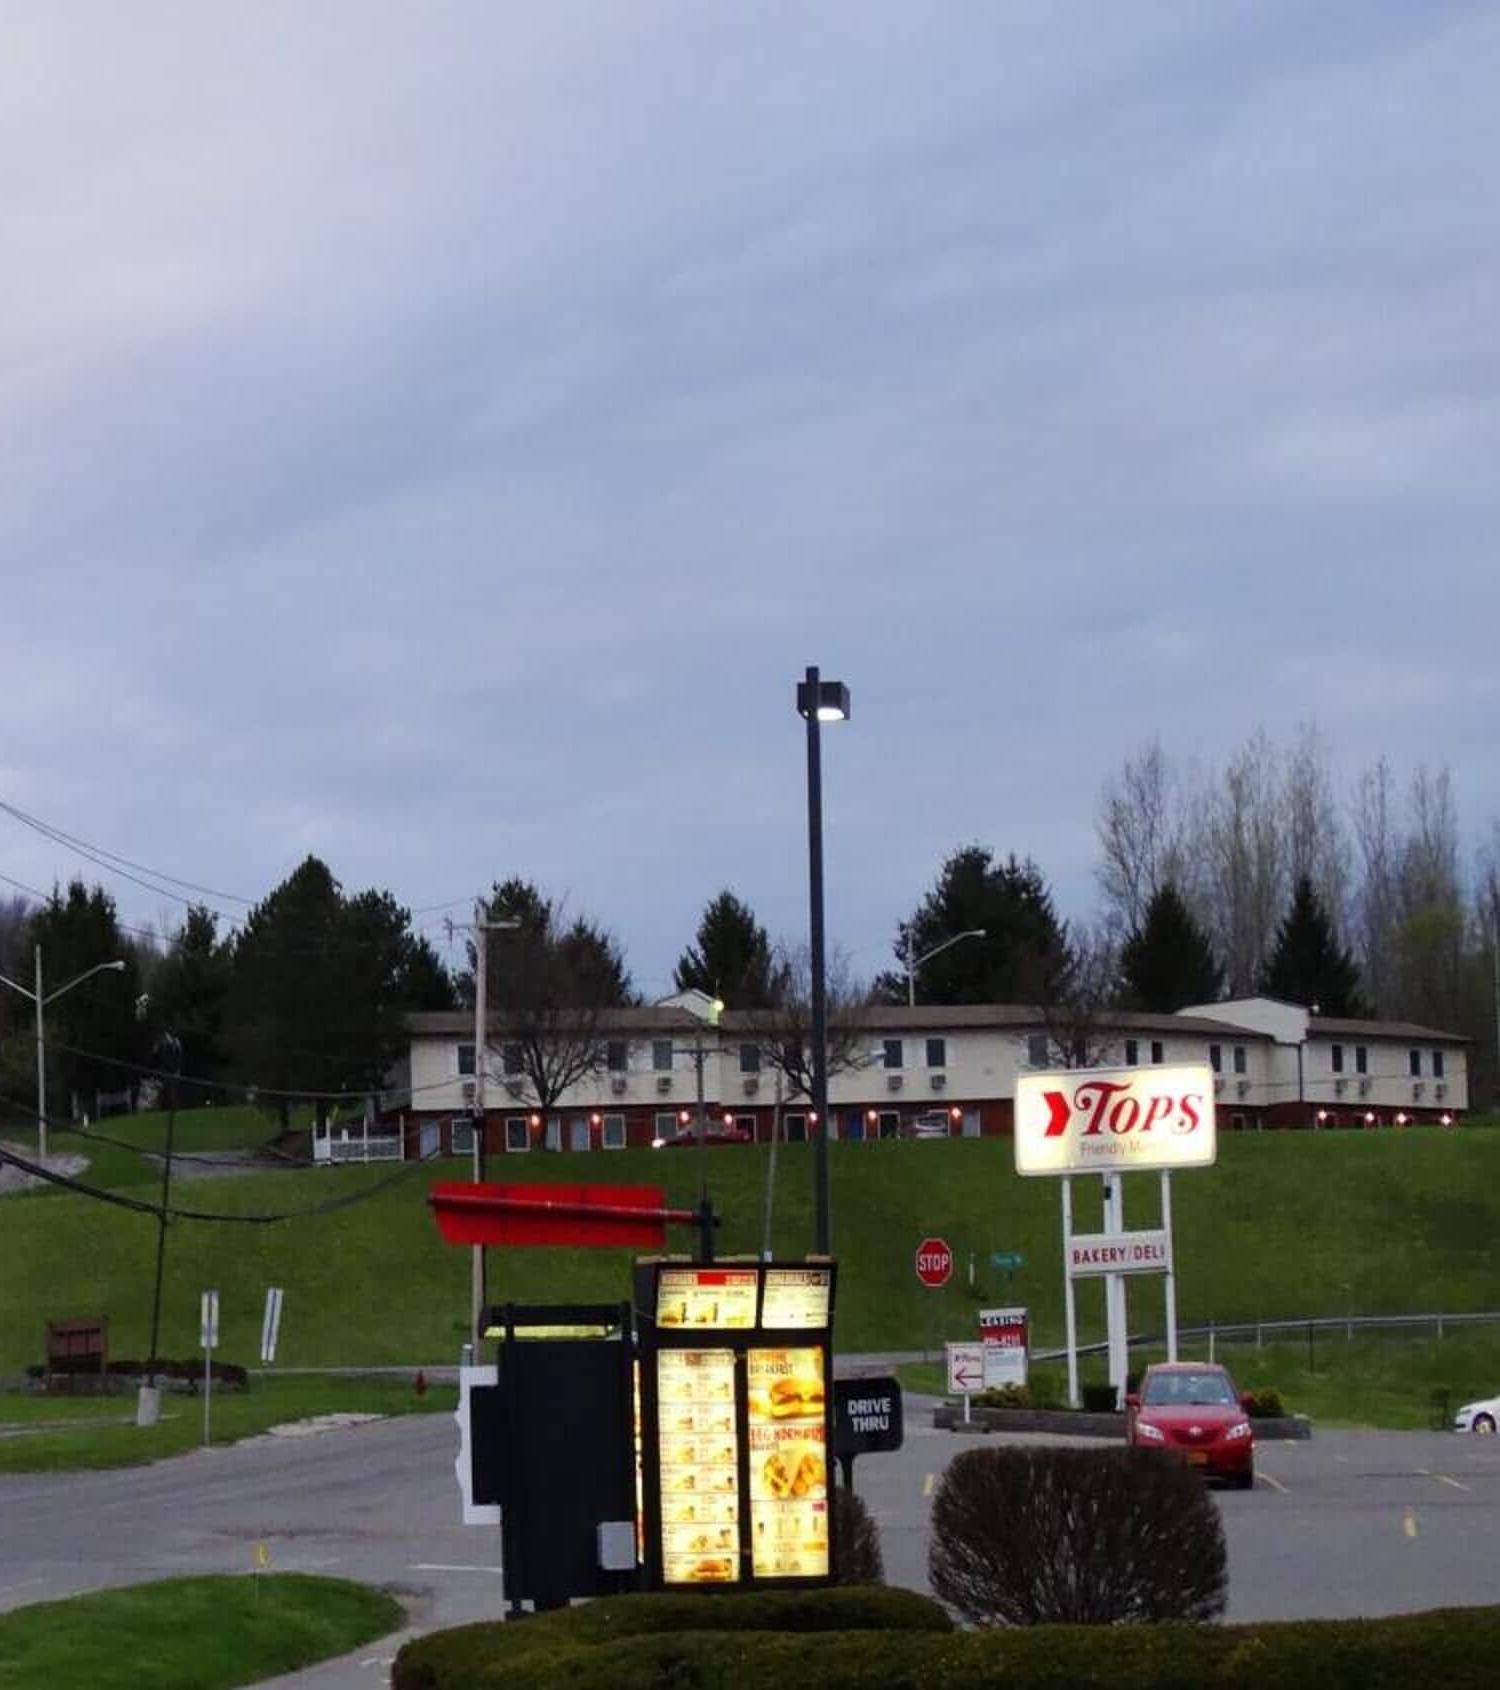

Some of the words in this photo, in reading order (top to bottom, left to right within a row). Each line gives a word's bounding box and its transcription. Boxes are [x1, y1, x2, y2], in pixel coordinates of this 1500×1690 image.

[919, 1253, 949, 1272] STOP
[847, 1398, 891, 1415] DRIVE
[852, 1415, 889, 1433] THRU
